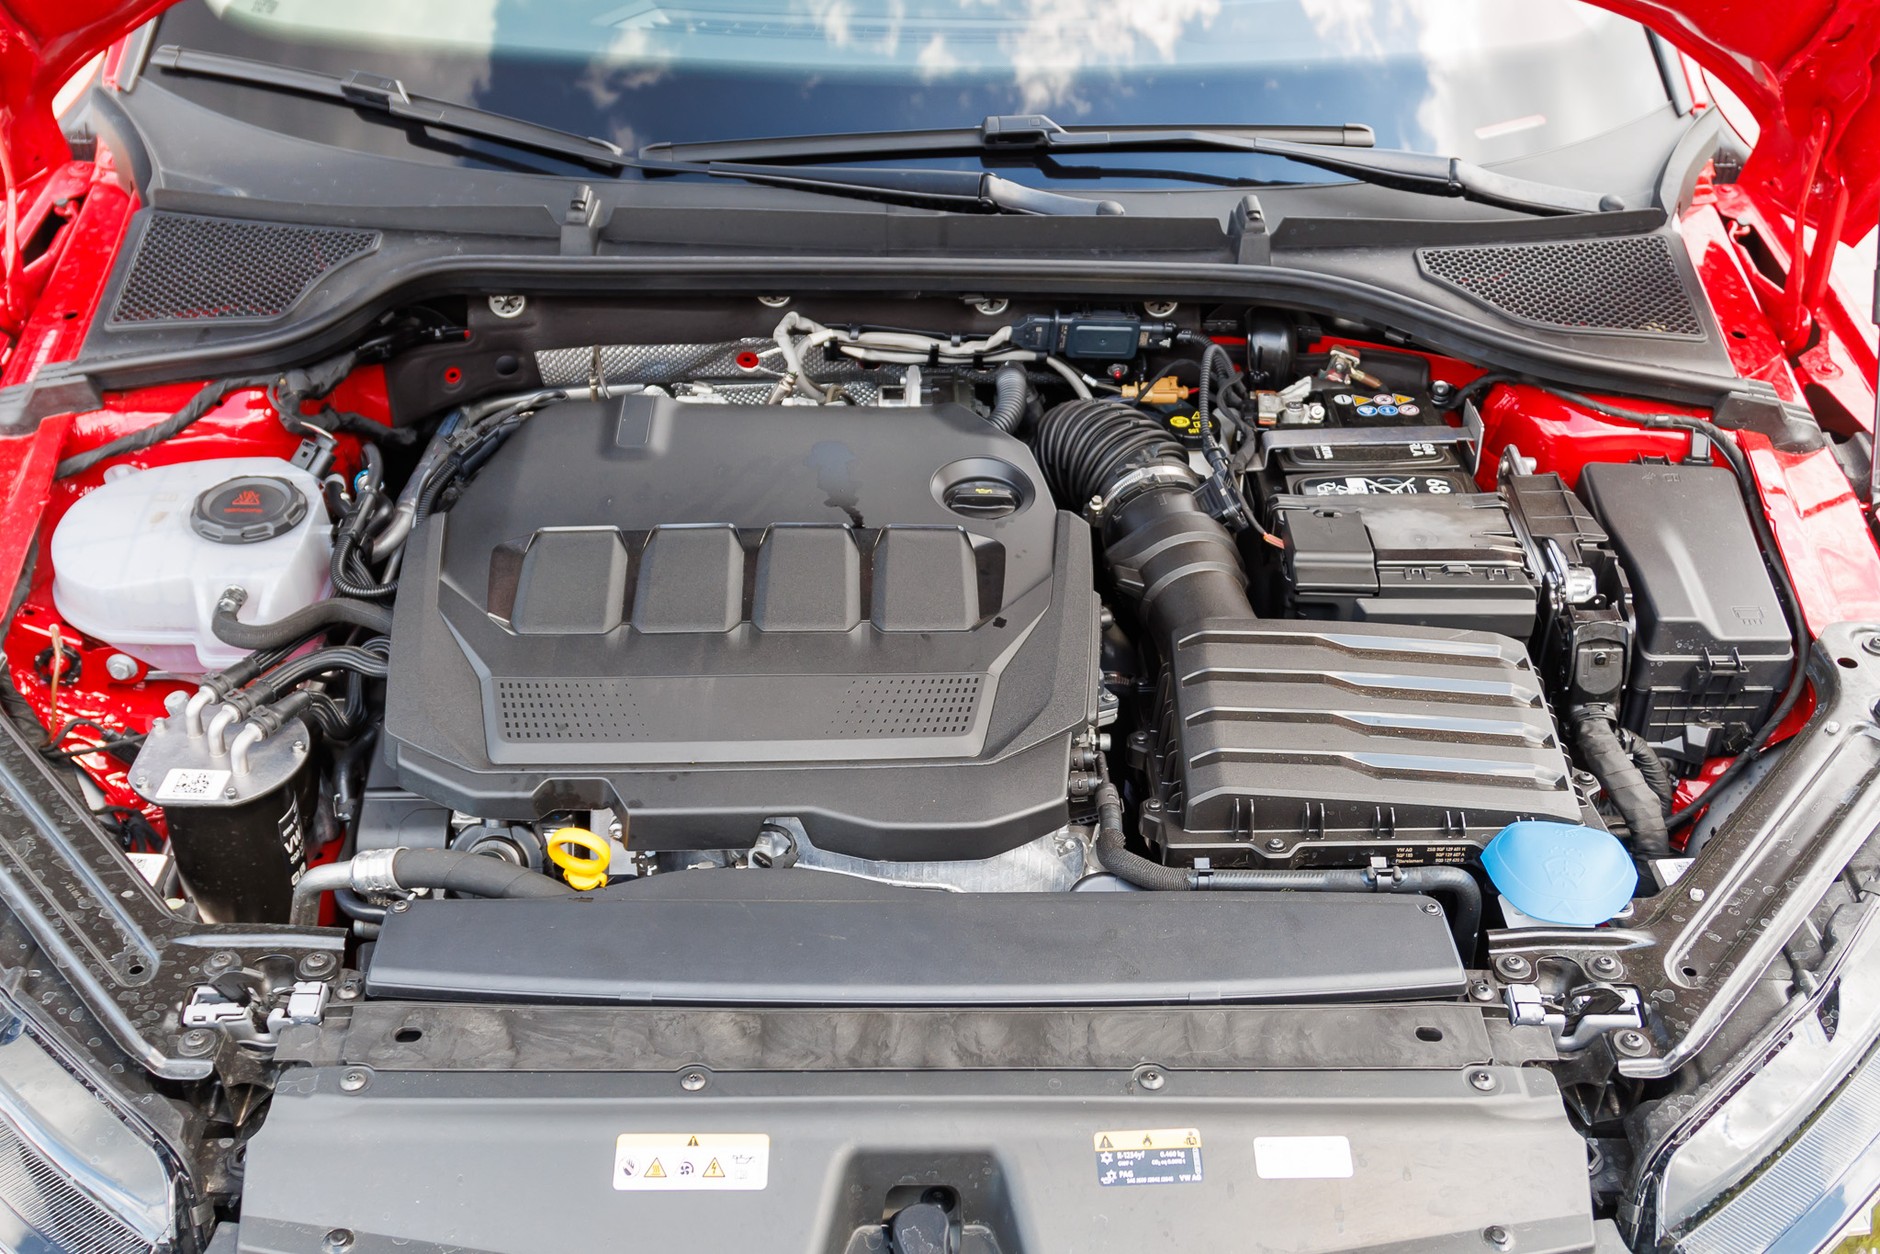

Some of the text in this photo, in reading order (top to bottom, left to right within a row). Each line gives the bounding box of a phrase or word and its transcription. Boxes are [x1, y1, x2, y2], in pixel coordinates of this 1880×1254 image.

[1409, 442, 1424, 457] RLA
[1425, 478, 1451, 494] 68
[1176, 1150, 1185, 1159] kg
[1118, 1170, 1134, 1178] PAG
[1179, 1174, 1191, 1182] VW
